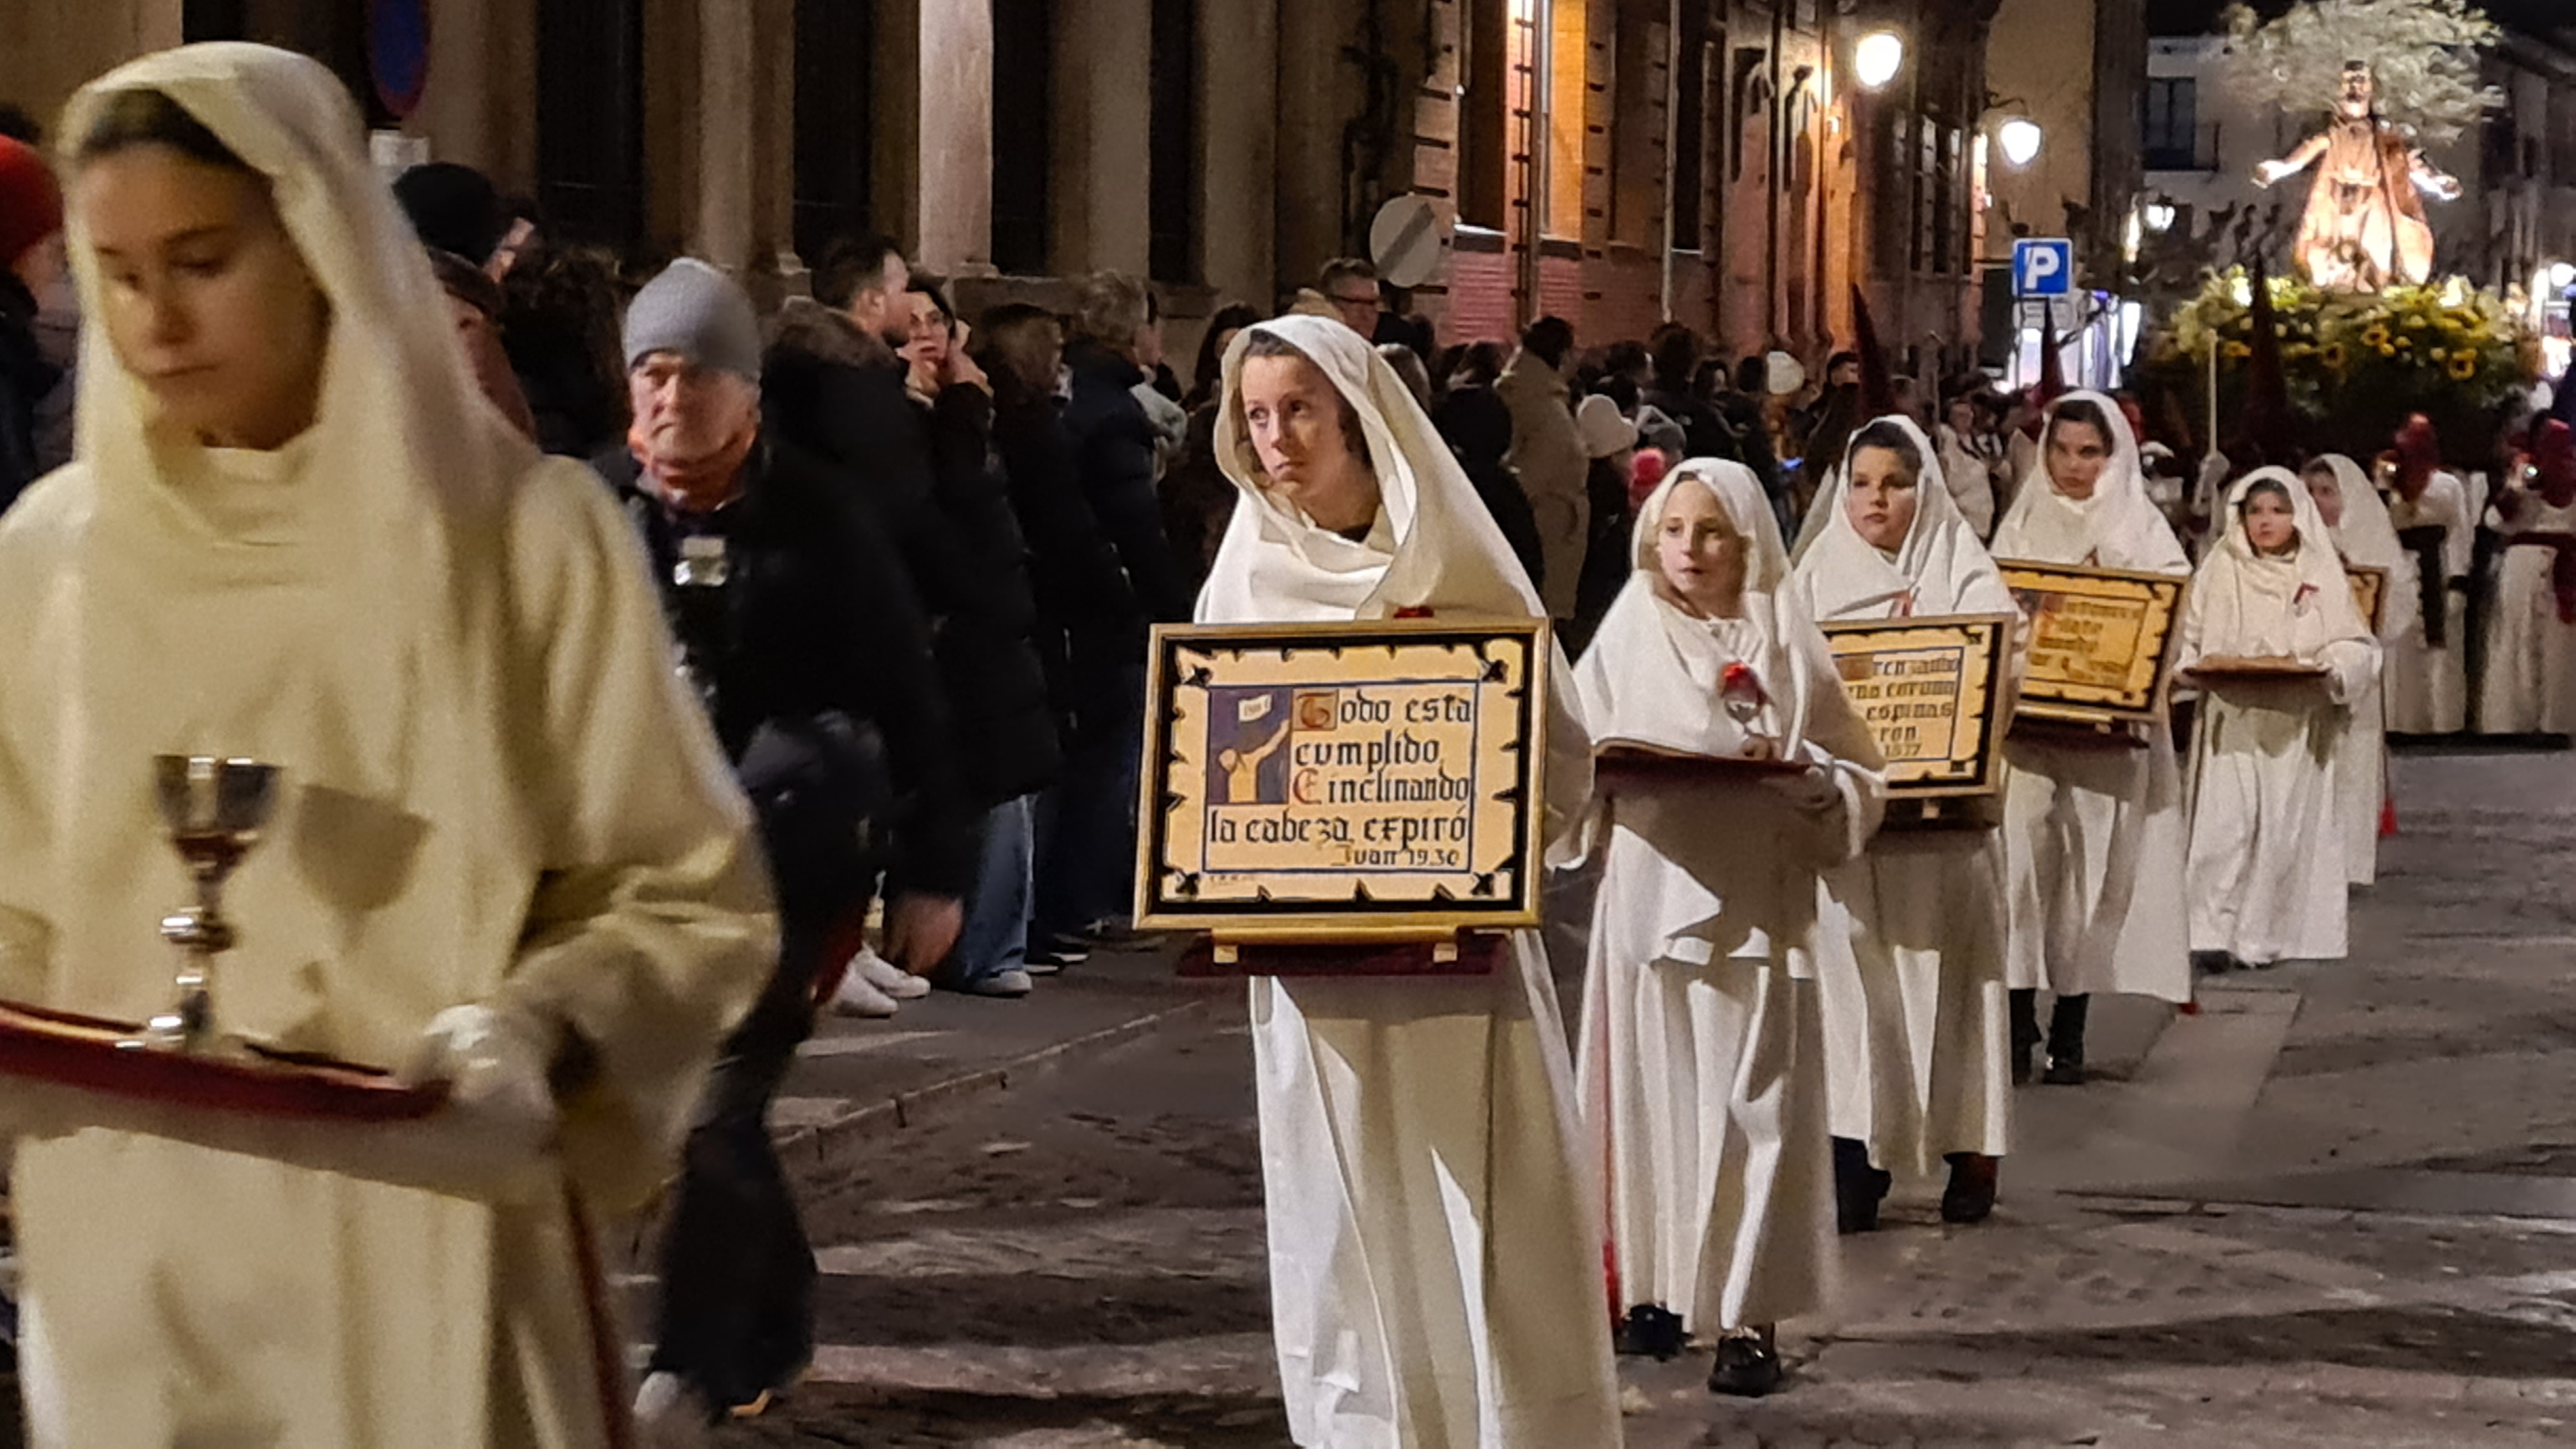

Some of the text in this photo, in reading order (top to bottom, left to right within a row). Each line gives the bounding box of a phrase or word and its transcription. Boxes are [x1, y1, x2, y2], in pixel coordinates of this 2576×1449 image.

[2024, 247, 2060, 289] P
[1296, 689, 1392, 728] Todo
[1328, 760, 1469, 803] inclinando
[1210, 809, 1236, 843] la
[1363, 804, 1467, 852] expiró
